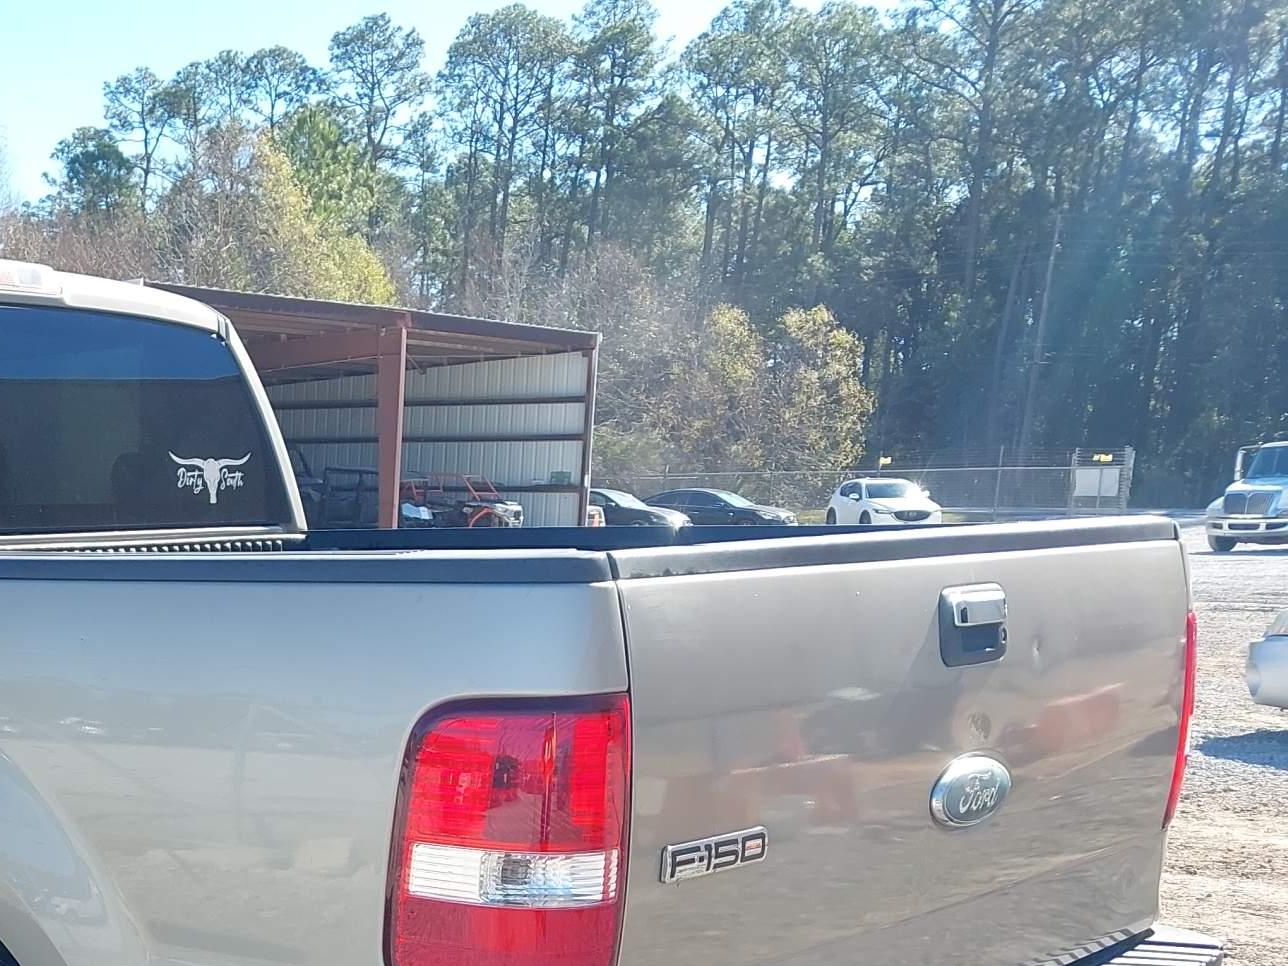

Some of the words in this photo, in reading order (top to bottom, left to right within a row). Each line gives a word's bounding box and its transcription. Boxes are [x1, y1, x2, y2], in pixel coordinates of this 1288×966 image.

[177, 467, 204, 494] Dirty
[959, 771, 1000, 814] Ford
[669, 832, 766, 879] F-150
